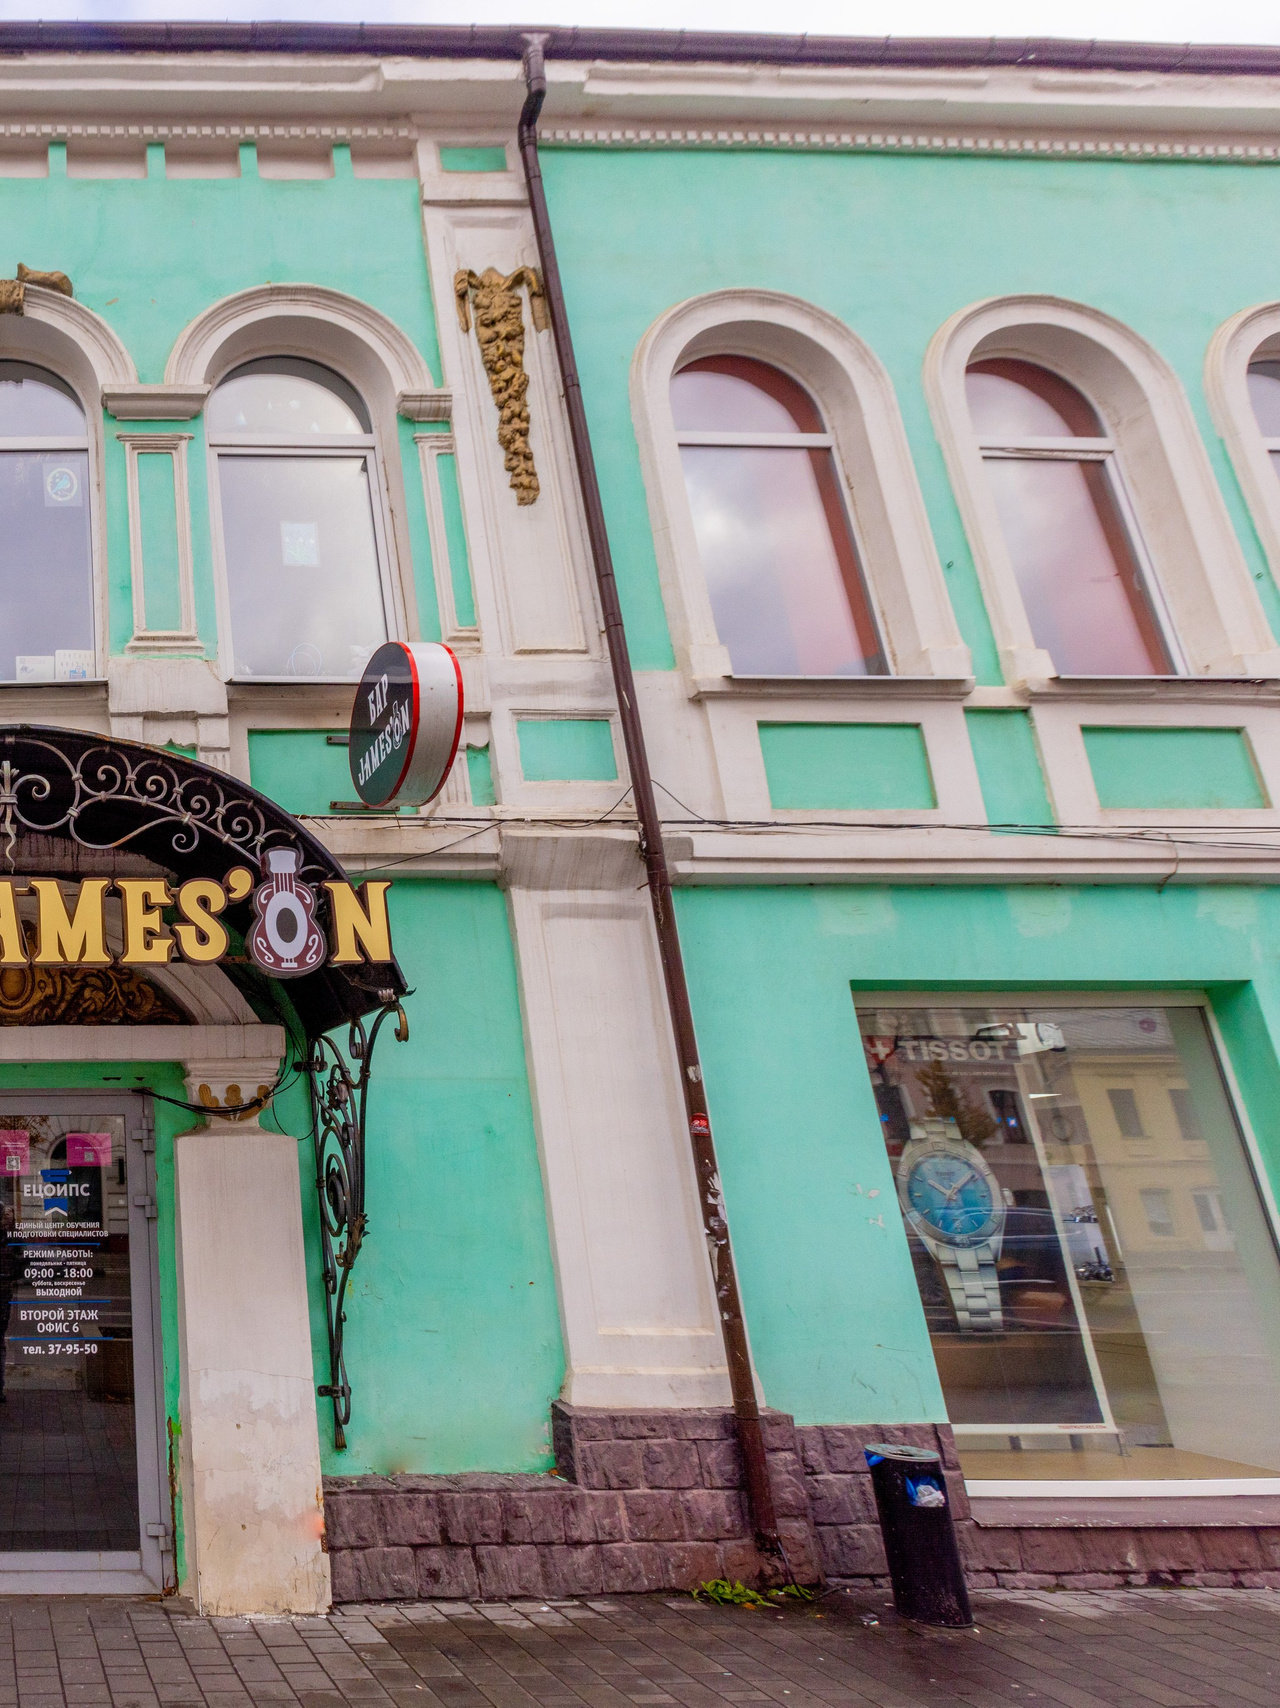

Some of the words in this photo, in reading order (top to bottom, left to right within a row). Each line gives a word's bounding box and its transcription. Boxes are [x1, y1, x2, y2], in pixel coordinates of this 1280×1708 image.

[368, 673, 389, 726] БАР
[897, 1040, 1009, 1062] TISSOT
[23, 1183, 91, 1198] ЕЦОИПС
[15, 1222, 44, 1230] ЕДИНЫЙ
[44, 1222, 65, 1230] ЦЕНТР
[66, 1221, 100, 1229] ОБУЧЕНИЯ
[58, 1230, 109, 1238] СПЕЦИАЛИСТОВ
[23, 1250, 55, 1258] РЕЖИМ
[56, 1250, 93, 1258] РАБОТЫ:
[24, 1268, 54, 1278] 09:00
[63, 1268, 93, 1278] 18:00
[36, 1287, 82, 1297] ВЫХОДНОЙ
[20, 1308, 65, 1320] ВТОРОЙ
[67, 1309, 99, 1320] ЭТАЖ
[37, 1322, 70, 1333] ОФИС
[72, 1322, 79, 1333] 6
[23, 1345, 45, 1354] тел.
[48, 1344, 98, 1354] 37-95-50
